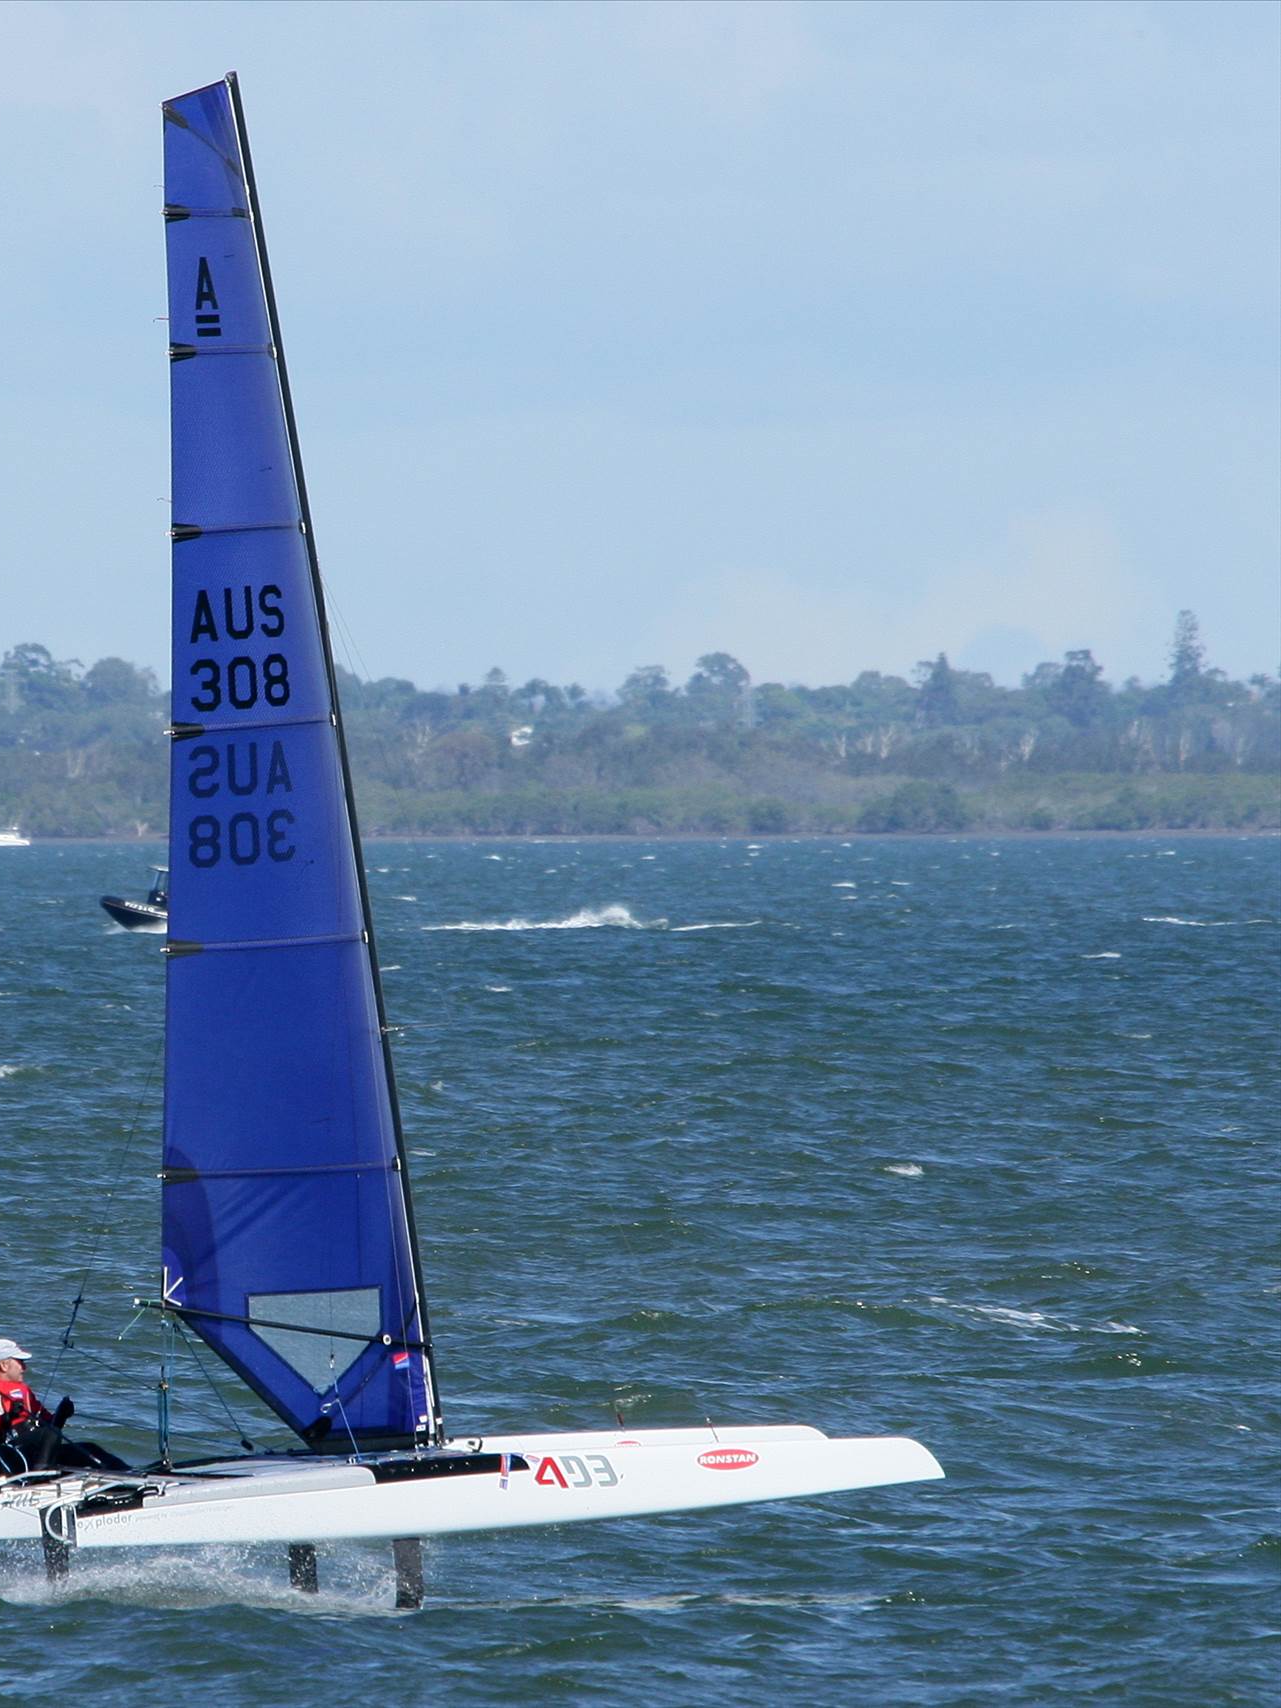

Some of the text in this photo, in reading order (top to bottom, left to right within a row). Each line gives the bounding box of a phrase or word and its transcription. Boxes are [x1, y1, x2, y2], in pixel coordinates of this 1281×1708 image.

[195, 256, 219, 310] A
[190, 584, 285, 643] AUS
[190, 653, 290, 712] 308
[699, 1452, 756, 1465] RONSTAN
